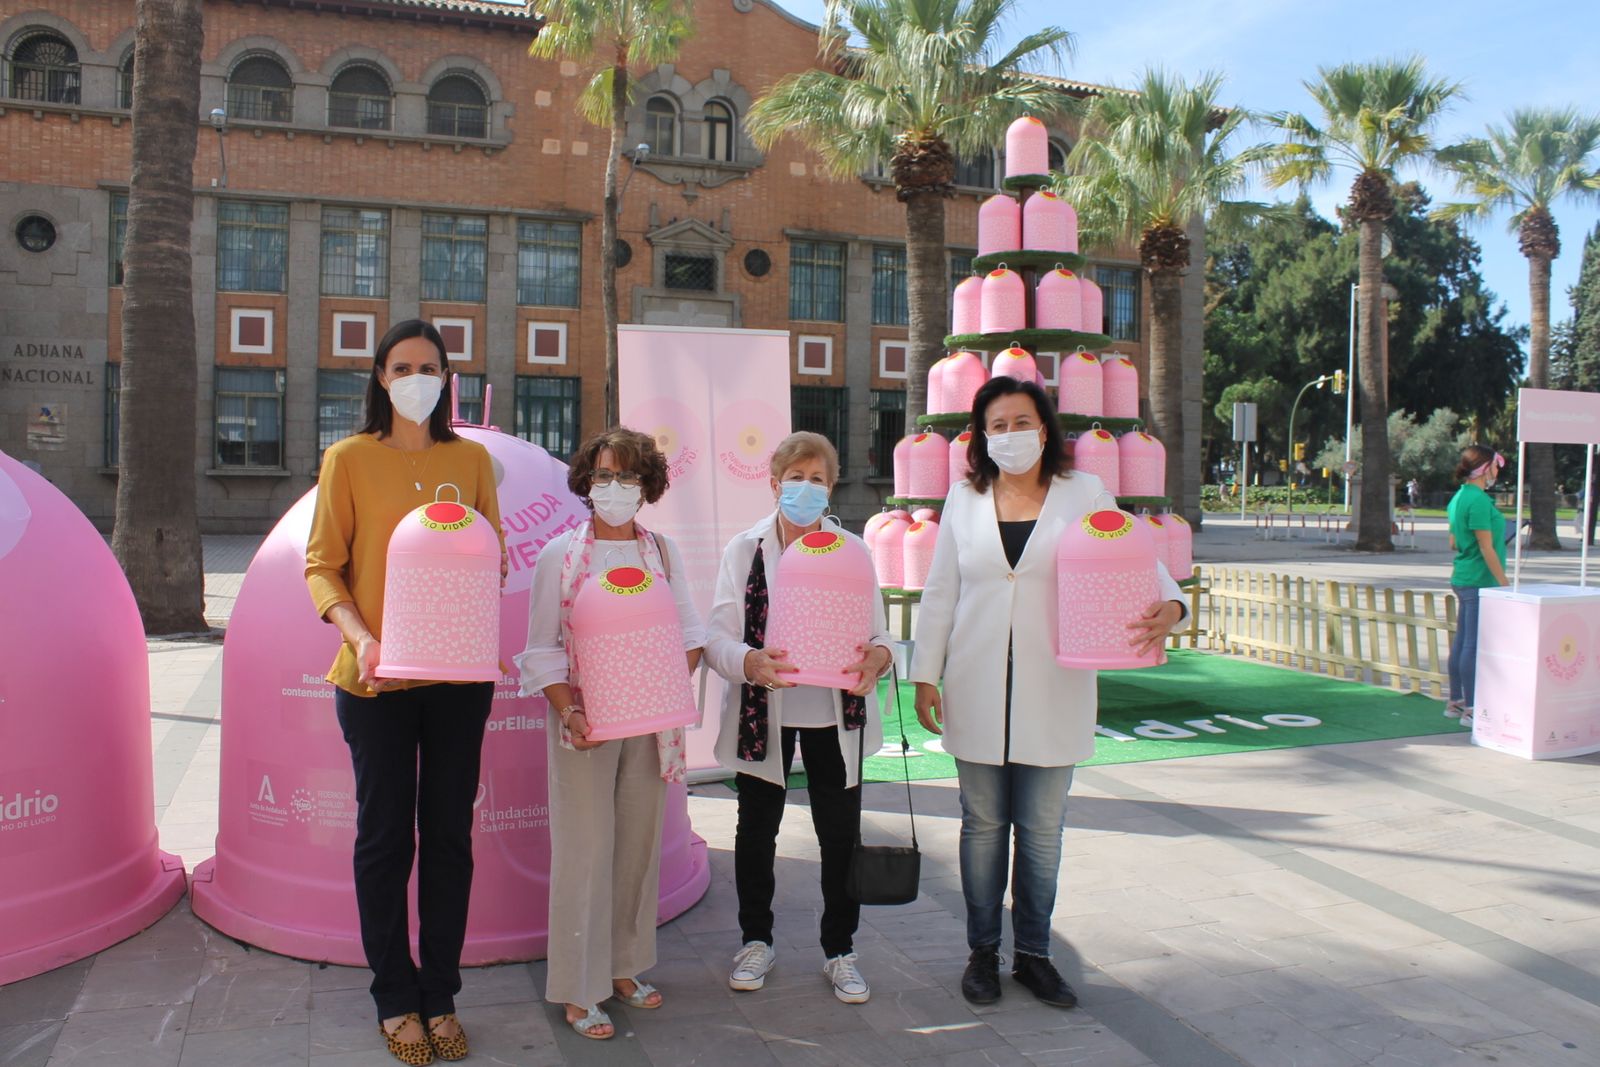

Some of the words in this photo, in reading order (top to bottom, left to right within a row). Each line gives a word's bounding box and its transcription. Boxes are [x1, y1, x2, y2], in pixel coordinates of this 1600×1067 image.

[13, 343, 84, 359] ADUANA
[2, 368, 94, 385] NACIONAL
[442, 516, 473, 531] VIDRIO
[1084, 525, 1105, 539] SOLO
[1108, 521, 1133, 538] VIDRIO
[812, 542, 841, 554] VIDRIO
[601, 581, 625, 595] SOLO
[628, 576, 653, 594] VIDRIO
[479, 804, 549, 822] Fundación
[479, 821, 516, 833] Sandra
[518, 818, 549, 830] Ibarra
